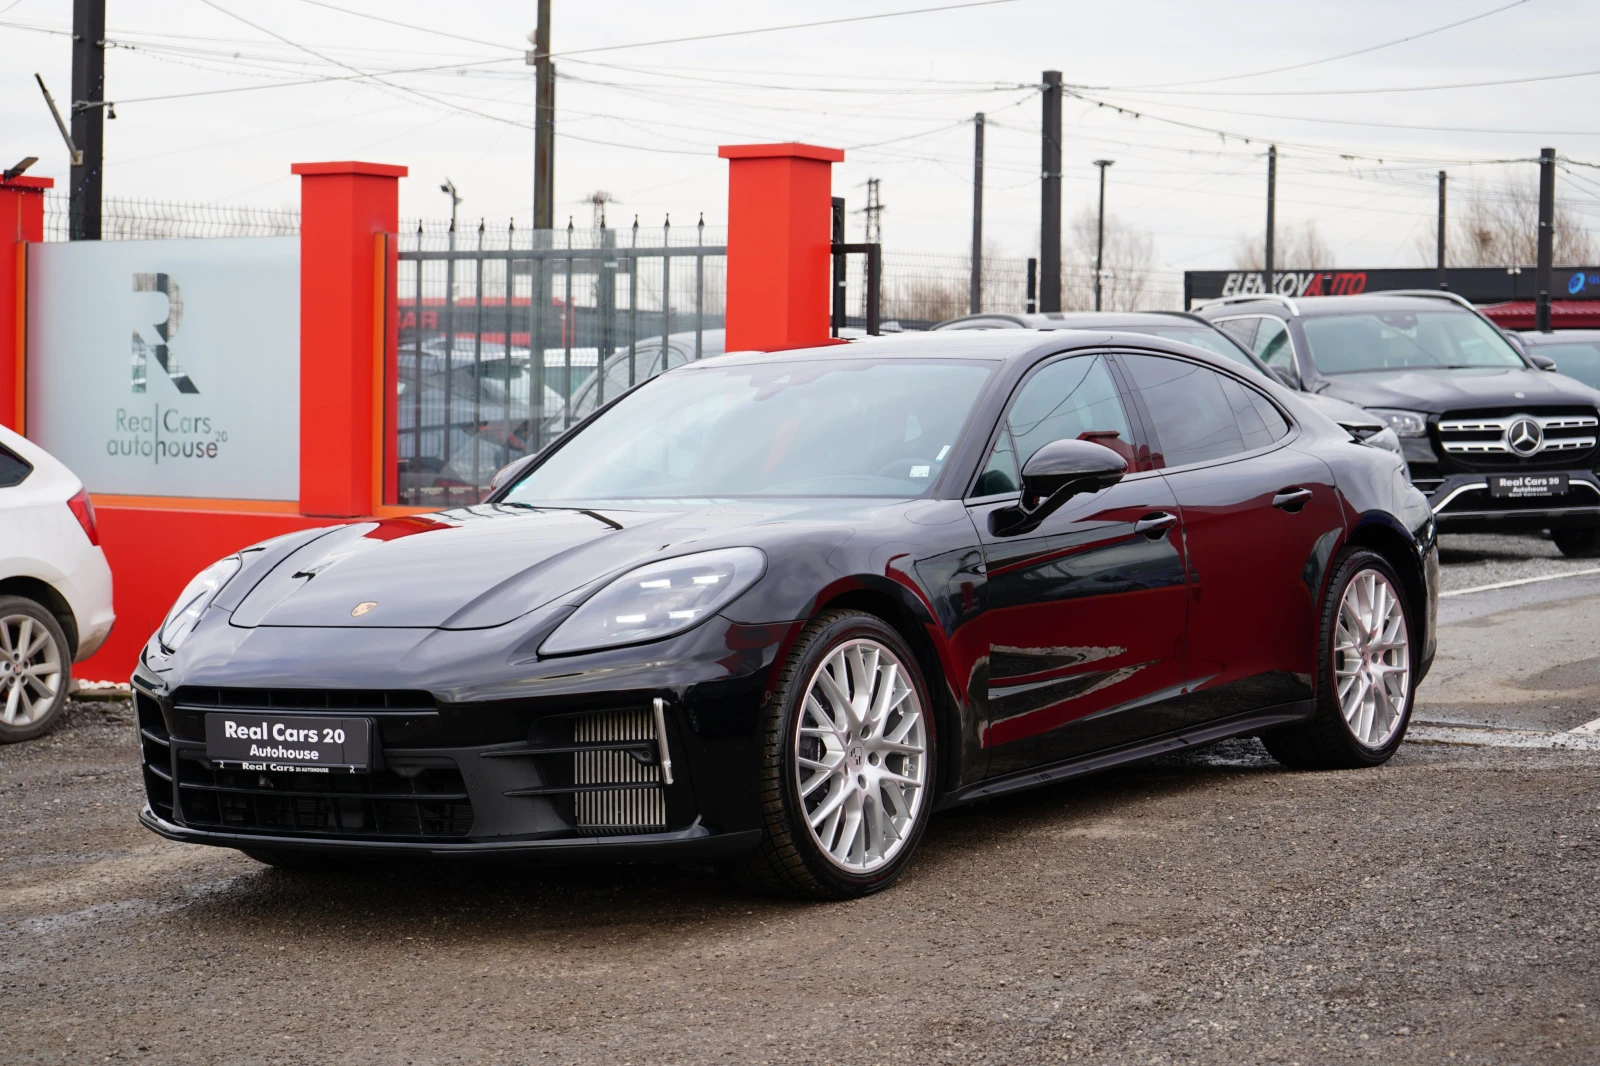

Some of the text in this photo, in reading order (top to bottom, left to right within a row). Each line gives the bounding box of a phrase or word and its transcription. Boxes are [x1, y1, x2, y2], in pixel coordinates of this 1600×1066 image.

[397, 310, 439, 330] AR
[163, 408, 212, 434] Cars
[215, 431, 229, 443] 20
[106, 434, 219, 460] autohouse
[1499, 476, 1560, 487] Real Cars 20
[224, 720, 346, 744] Real Cars 20
[249, 744, 319, 760] Autohouse
[242, 762, 267, 771] Real
[270, 763, 295, 772] Cars
